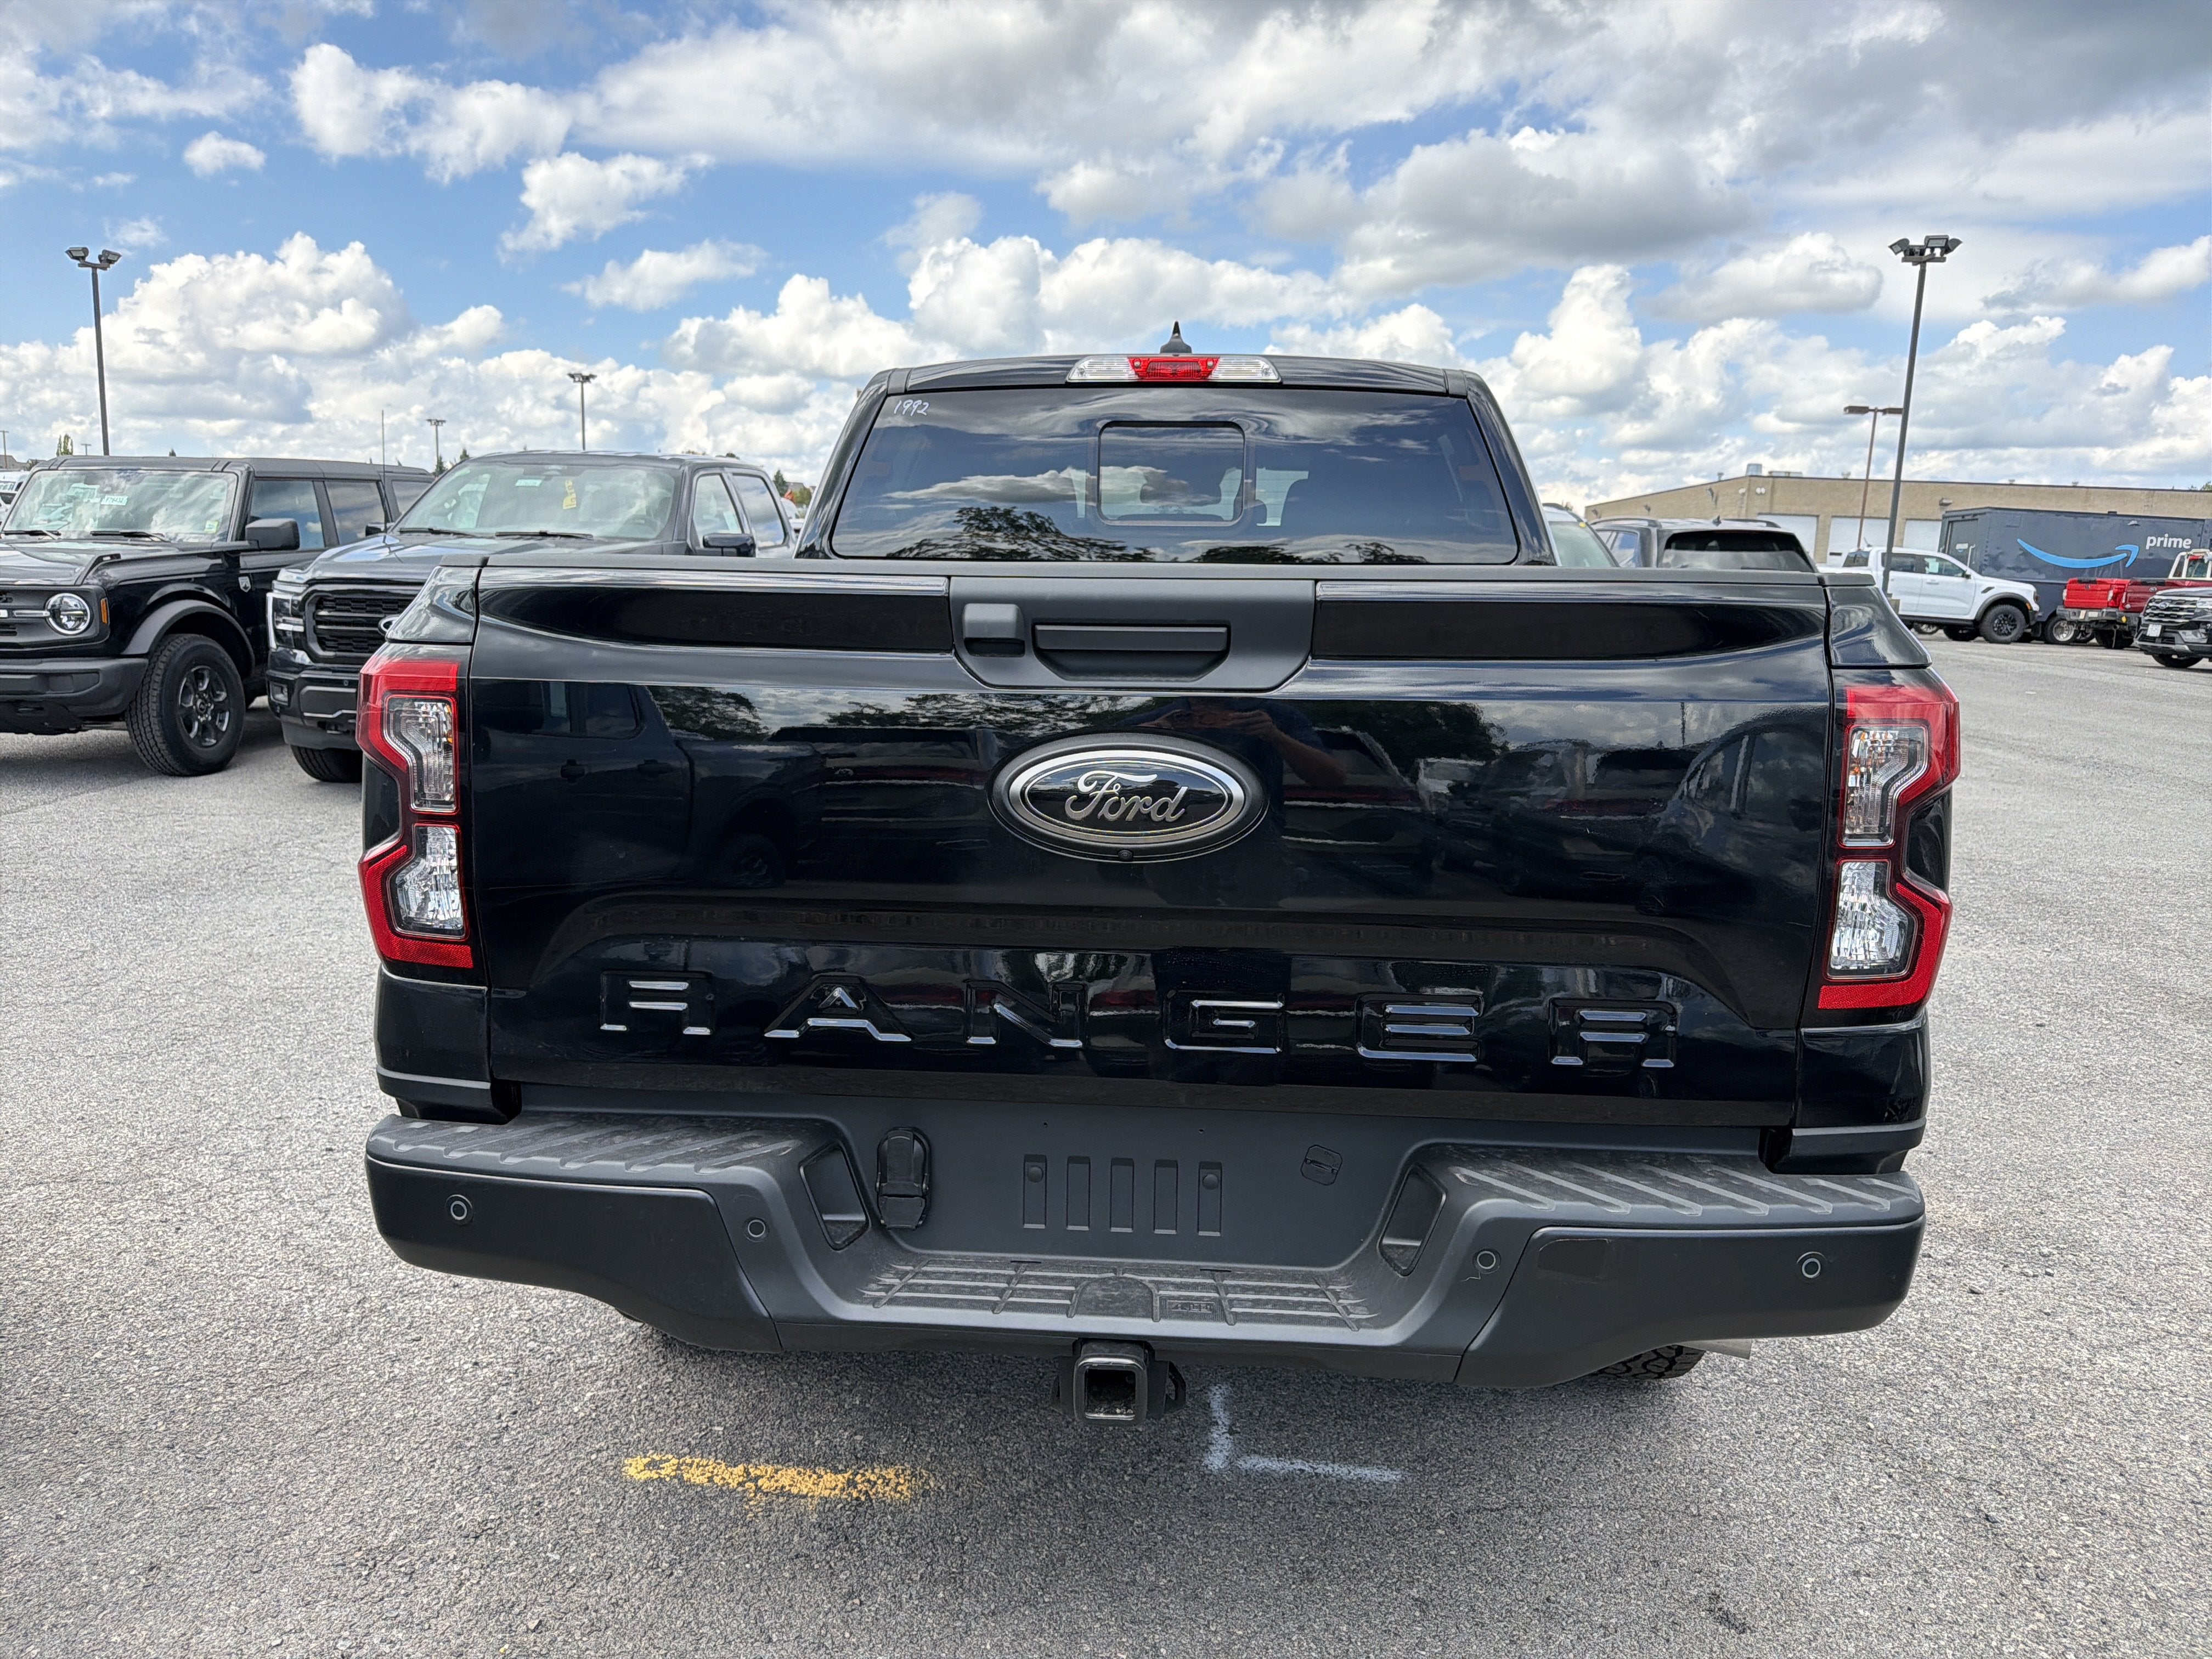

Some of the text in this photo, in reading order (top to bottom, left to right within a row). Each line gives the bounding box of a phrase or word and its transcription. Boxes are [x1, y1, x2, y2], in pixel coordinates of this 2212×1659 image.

[894, 399, 929, 416] 1992
[2146, 533, 2192, 550] prime
[1065, 770, 1188, 822] Ford
[599, 970, 1678, 1068] RANGER
